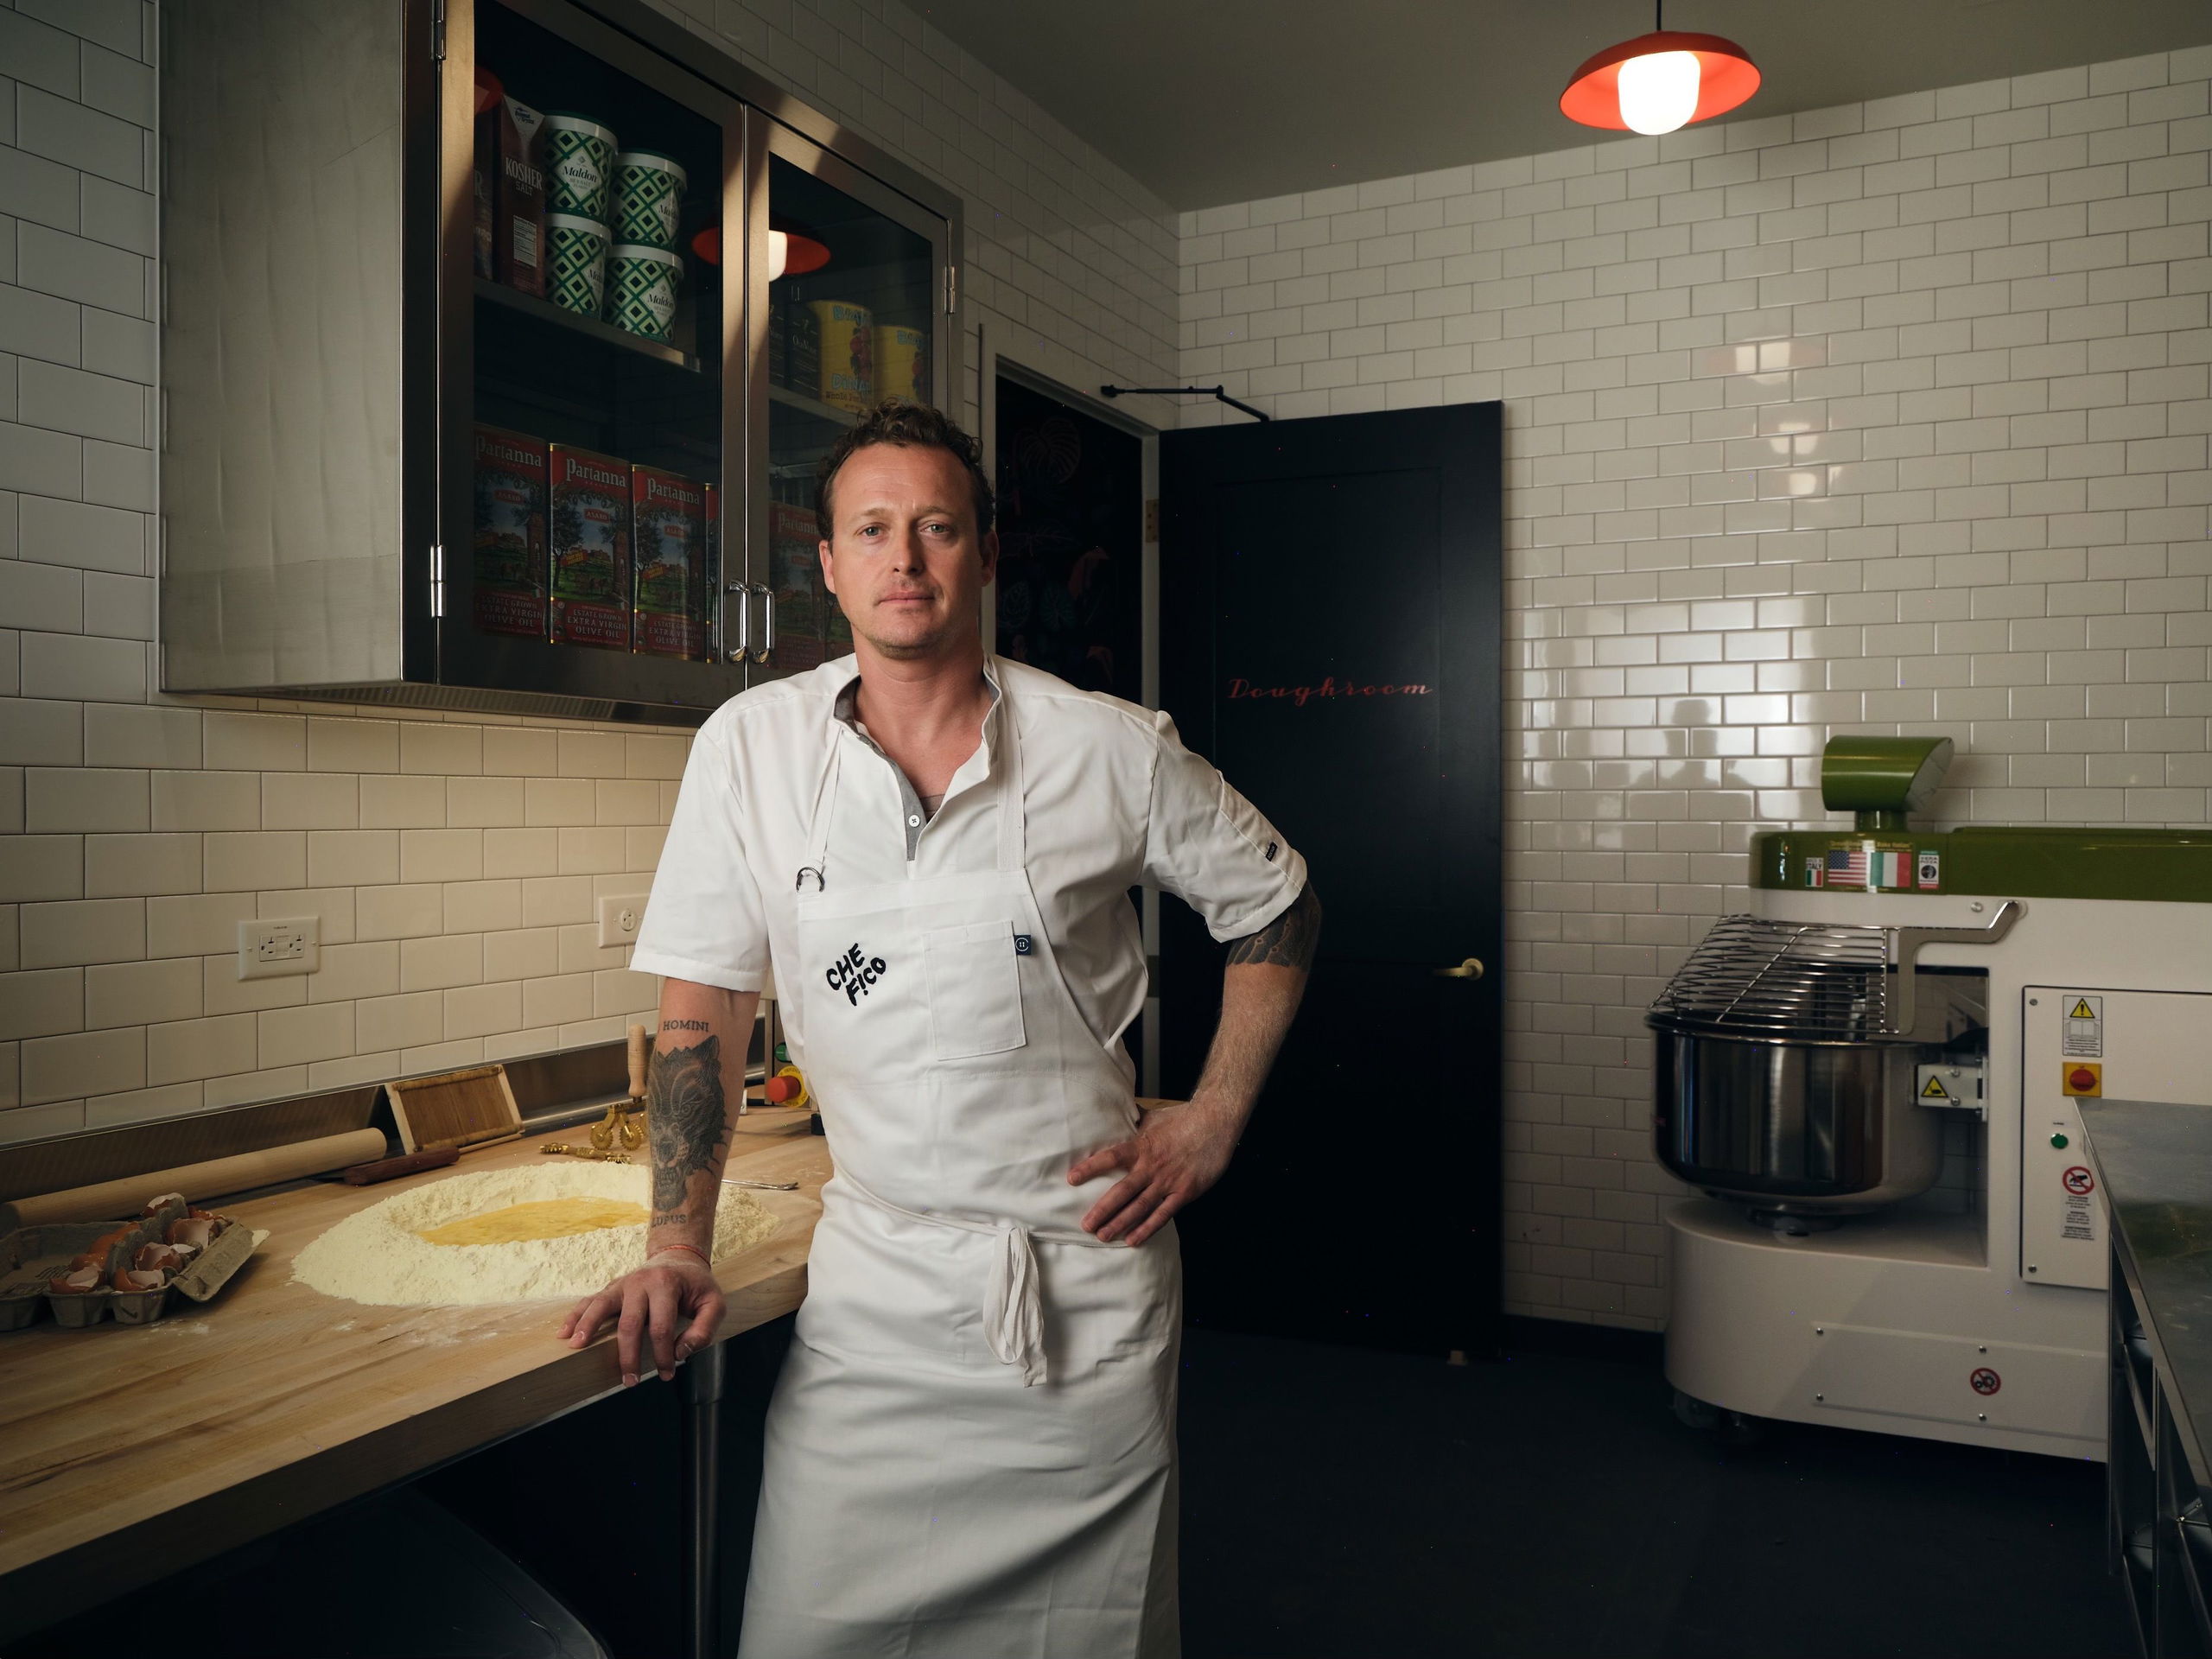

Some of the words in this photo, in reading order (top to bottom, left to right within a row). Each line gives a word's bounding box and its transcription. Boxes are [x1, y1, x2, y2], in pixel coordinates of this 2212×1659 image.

[505, 156, 543, 190] KOSHER
[563, 166, 597, 182] Maldon
[515, 181, 532, 196] SALT
[566, 458, 626, 487] Partanna
[647, 477, 700, 505] Partanna
[518, 617, 535, 628] OIL
[573, 609, 597, 619] ESTATE
[598, 612, 622, 621] GROWN
[567, 616, 596, 626] EXTRA
[599, 620, 626, 631] VIRGIN
[575, 626, 602, 637] OLIVE
[605, 628, 620, 639] OIL
[1226, 677, 1433, 707] Doughroom
[826, 943, 865, 990] CHE
[663, 1020, 709, 1033] HOMINI
[651, 1214, 687, 1228] LUPUS
